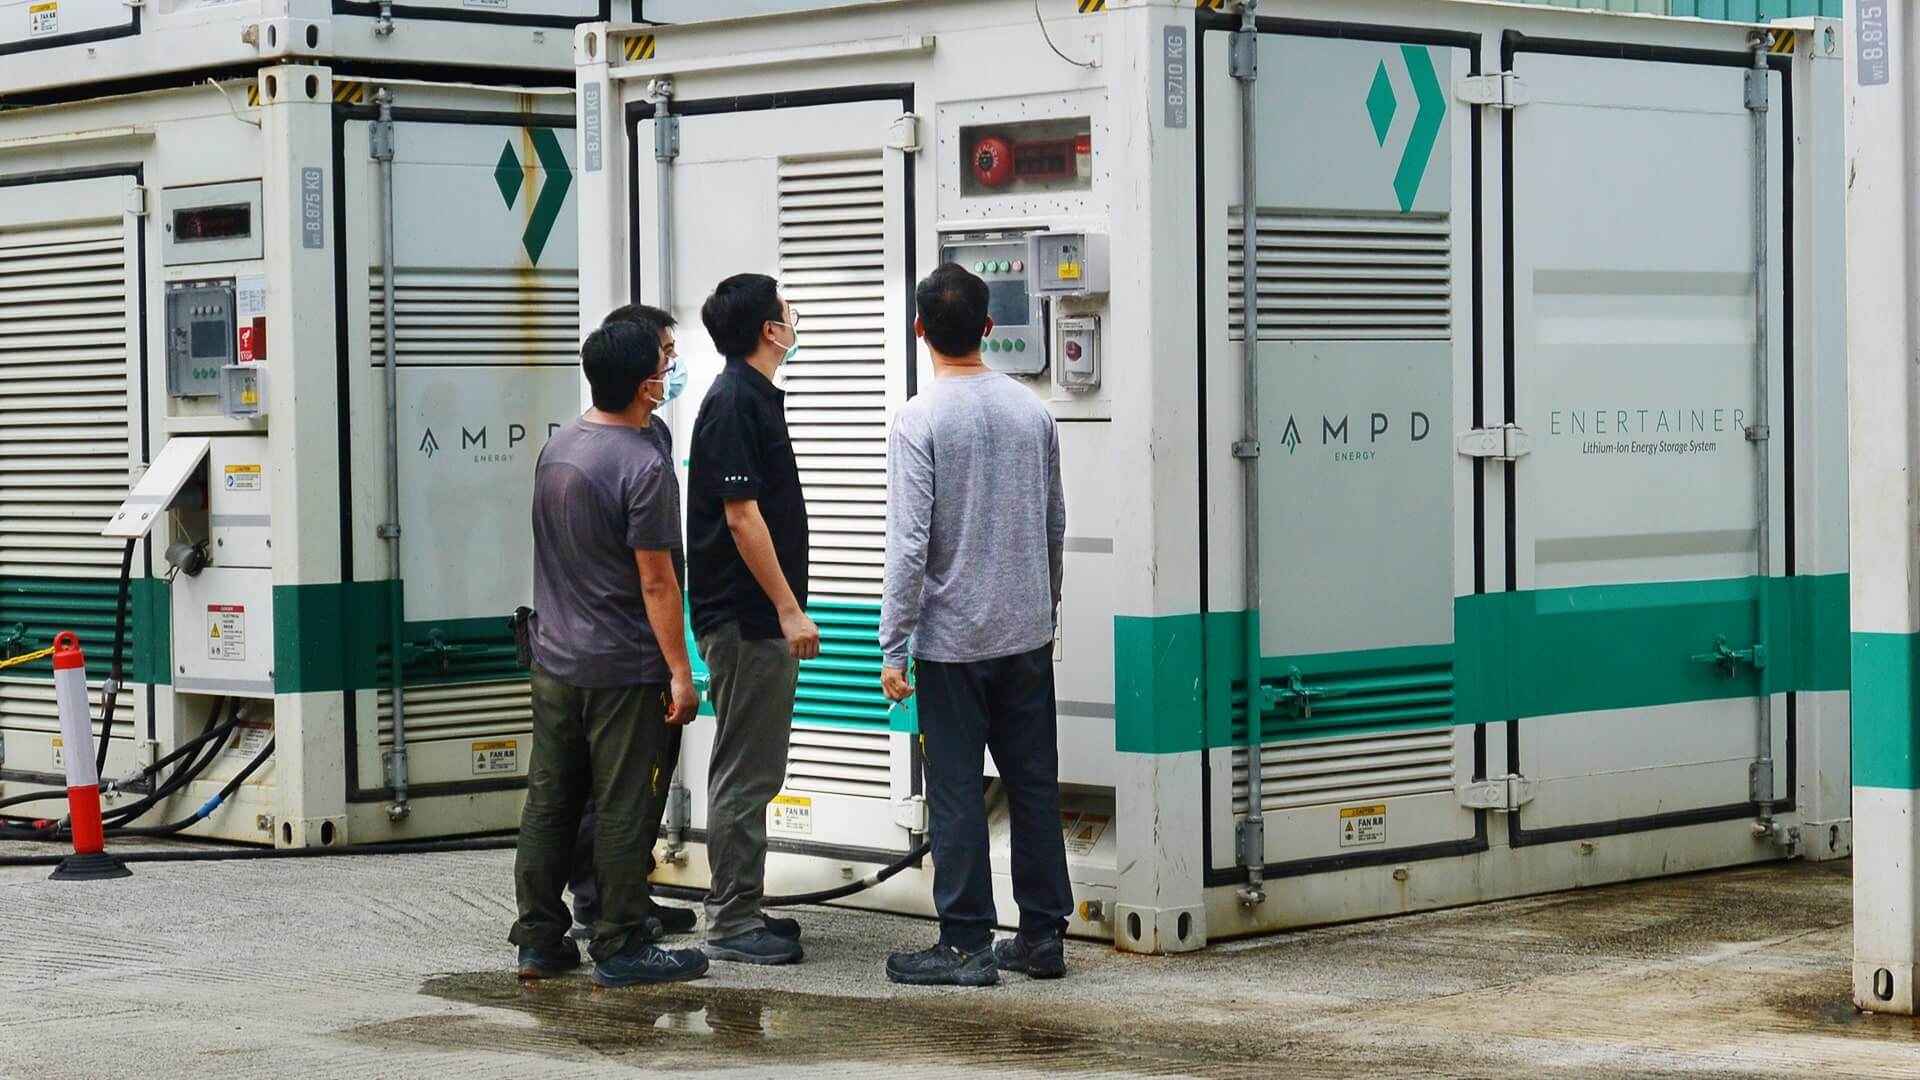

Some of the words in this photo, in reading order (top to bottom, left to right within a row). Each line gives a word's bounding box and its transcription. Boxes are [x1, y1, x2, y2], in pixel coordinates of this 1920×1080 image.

[1168, 35, 1183, 58] KG
[586, 91, 599, 111] KG
[305, 171, 320, 189] KG
[1281, 411, 1430, 448] AMPD
[1551, 408, 1746, 435] ENERTAINER
[1335, 450, 1376, 462] ENERGY
[1582, 441, 1629, 454] Lithium-Ion
[1631, 441, 1658, 455] Energy
[1659, 440, 1688, 455] Storage
[1689, 440, 1717, 454] System
[474, 454, 514, 463] ENERGY
[1358, 818, 1372, 826] FAN
